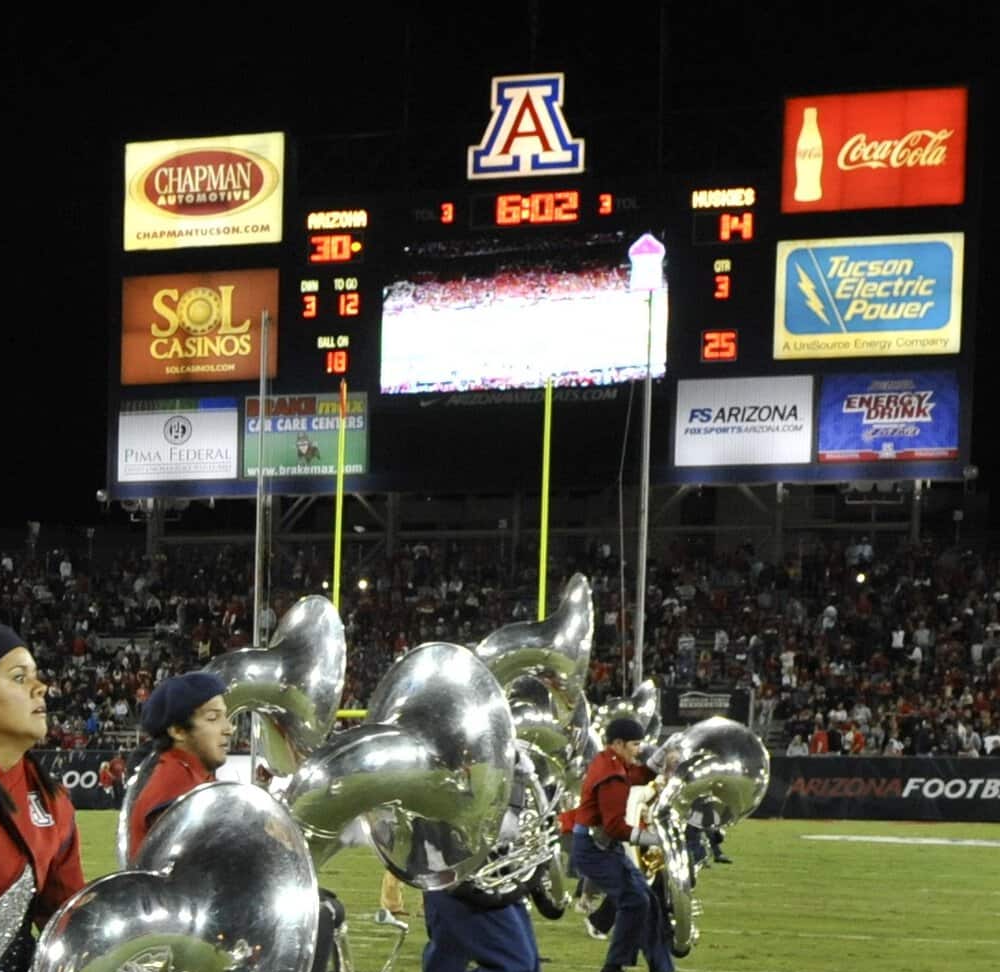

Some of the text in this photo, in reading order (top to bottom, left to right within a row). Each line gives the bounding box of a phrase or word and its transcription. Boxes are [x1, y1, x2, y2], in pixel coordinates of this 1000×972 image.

[467, 72, 585, 180] A
[154, 162, 251, 194] CHAPMAN
[157, 190, 250, 205] AUTOMOTIVE
[496, 192, 578, 224] 6:02
[599, 194, 612, 215] 3
[692, 188, 755, 208] HUSKIES
[308, 210, 367, 229] ARIZONA
[441, 203, 453, 223] 3
[136, 223, 271, 240] CHAPMANTUCSON.COM
[720, 213, 753, 240] 14
[310, 235, 351, 262] 30
[827, 255, 914, 278] Tucson
[714, 275, 730, 298] 3
[835, 275, 936, 299] Electric
[151, 285, 250, 337] SOL
[303, 295, 317, 318] 3
[339, 293, 359, 316] 12
[844, 300, 934, 321] Power
[151, 335, 251, 359] CASINOS
[703, 332, 736, 359] 25
[782, 342, 791, 351] A
[854, 338, 892, 350] Energy
[896, 336, 949, 349] Company
[845, 392, 929, 411] ENERGY
[276, 417, 308, 431] CARE
[866, 406, 929, 420] DRINK
[247, 464, 363, 476] www.brakemax.om
[788, 777, 1000, 799] ARIZONA FOOTB
